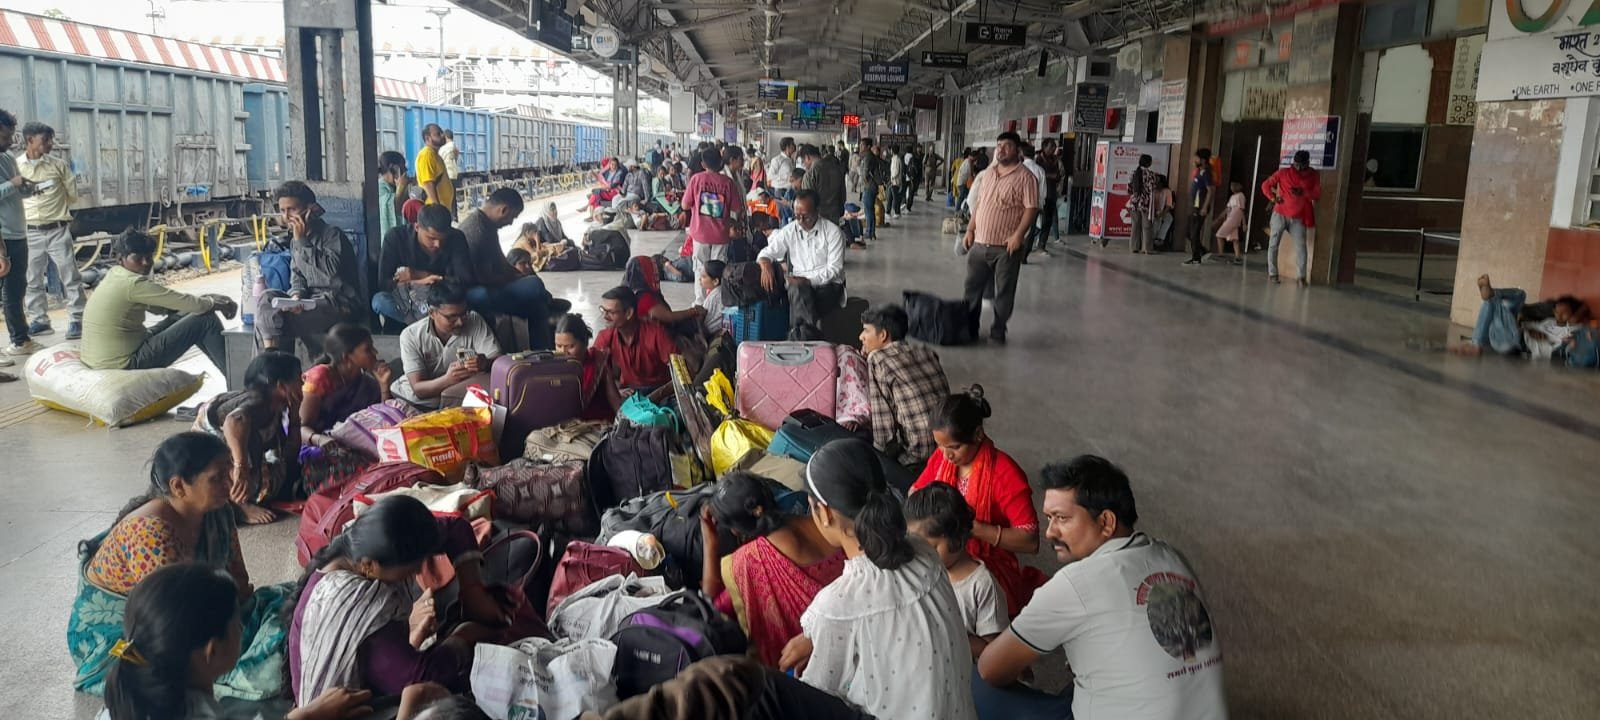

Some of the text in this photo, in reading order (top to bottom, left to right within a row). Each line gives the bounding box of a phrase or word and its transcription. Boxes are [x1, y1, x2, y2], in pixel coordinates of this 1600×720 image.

[994, 33, 1009, 41] EXIT
[1553, 32, 1596, 54] भारत
[864, 73, 905, 83] RESERVED LOUNGE
[1516, 83, 1560, 96] ONE EARTH
[1575, 80, 1594, 92] ONE
